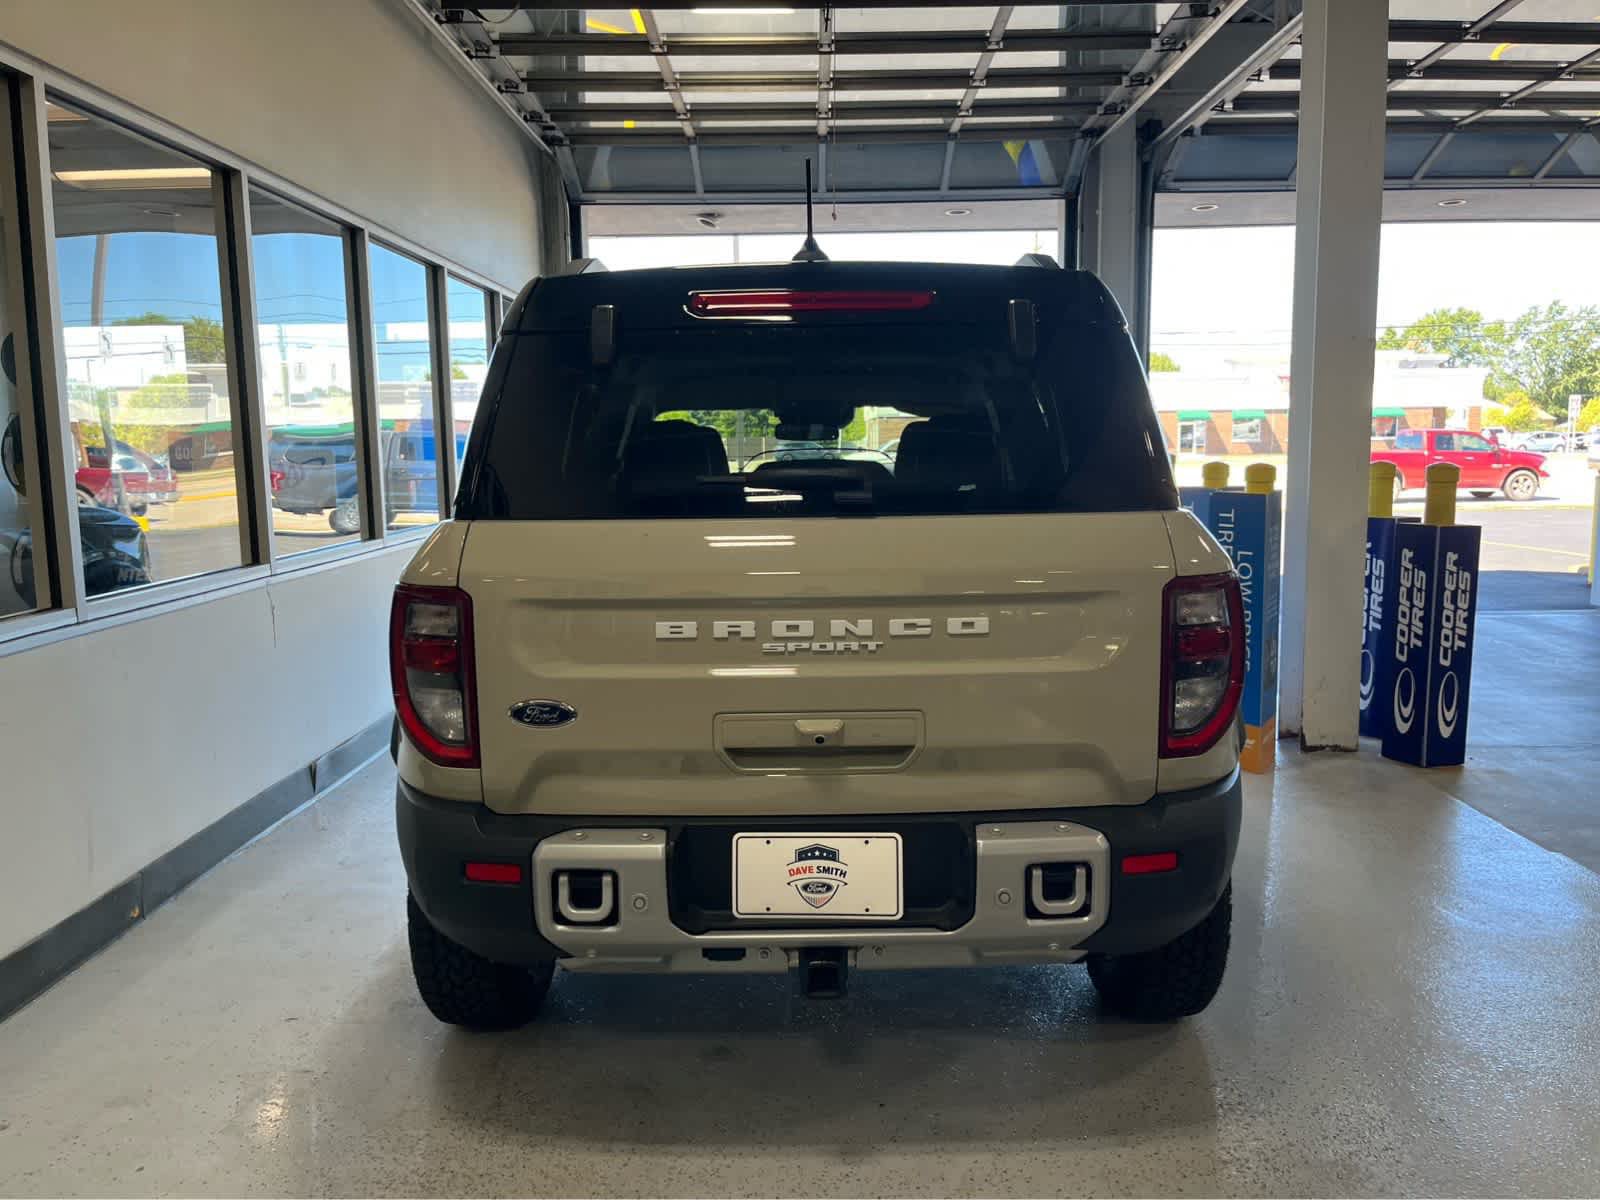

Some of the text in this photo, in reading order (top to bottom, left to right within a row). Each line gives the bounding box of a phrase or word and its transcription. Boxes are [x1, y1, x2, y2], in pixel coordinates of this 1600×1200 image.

[1236, 551, 1253, 606] LOW
[1369, 557, 1385, 632] TIRES
[1395, 548, 1414, 662] COOPER
[1410, 567, 1426, 648] TIRES
[1440, 552, 1459, 667] COOPER
[1454, 569, 1471, 651] TIRES
[655, 616, 991, 639] BRONCO
[762, 641, 884, 655] SPORT
[788, 865, 848, 878] DAVE SMITH
[806, 882, 828, 893] Ford
